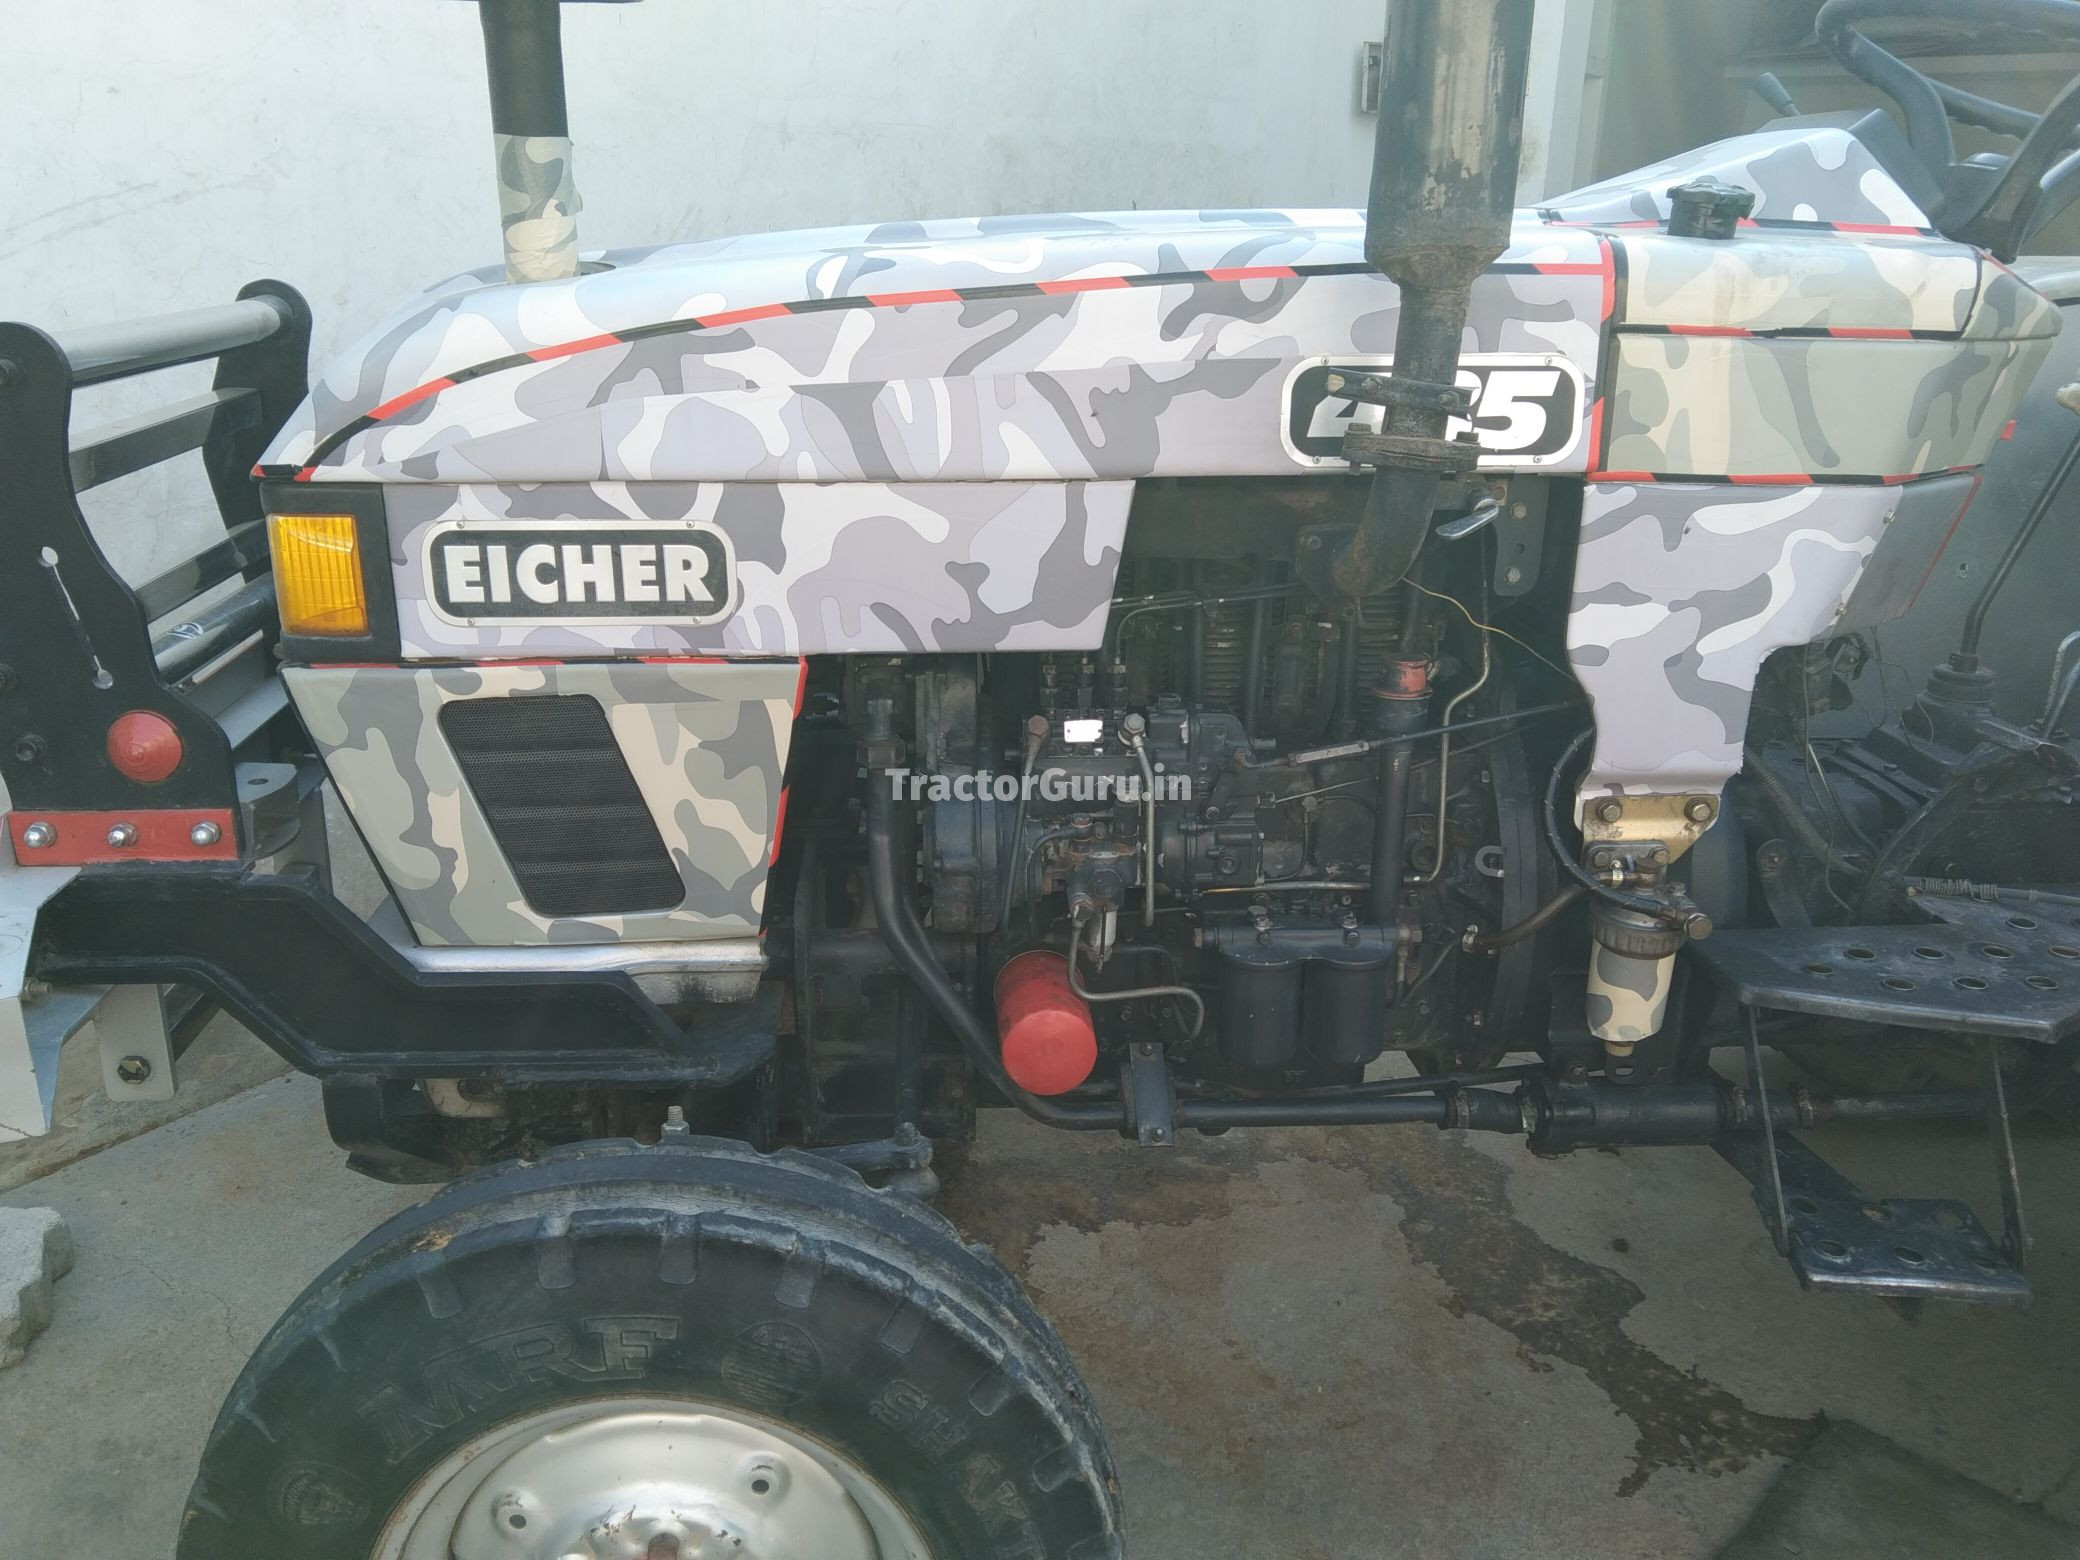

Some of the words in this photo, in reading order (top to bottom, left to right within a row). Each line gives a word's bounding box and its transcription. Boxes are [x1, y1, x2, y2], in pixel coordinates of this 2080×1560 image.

[1307, 370, 1561, 450] 45
[443, 544, 715, 604] EICHER
[354, 1314, 681, 1466] MRF
